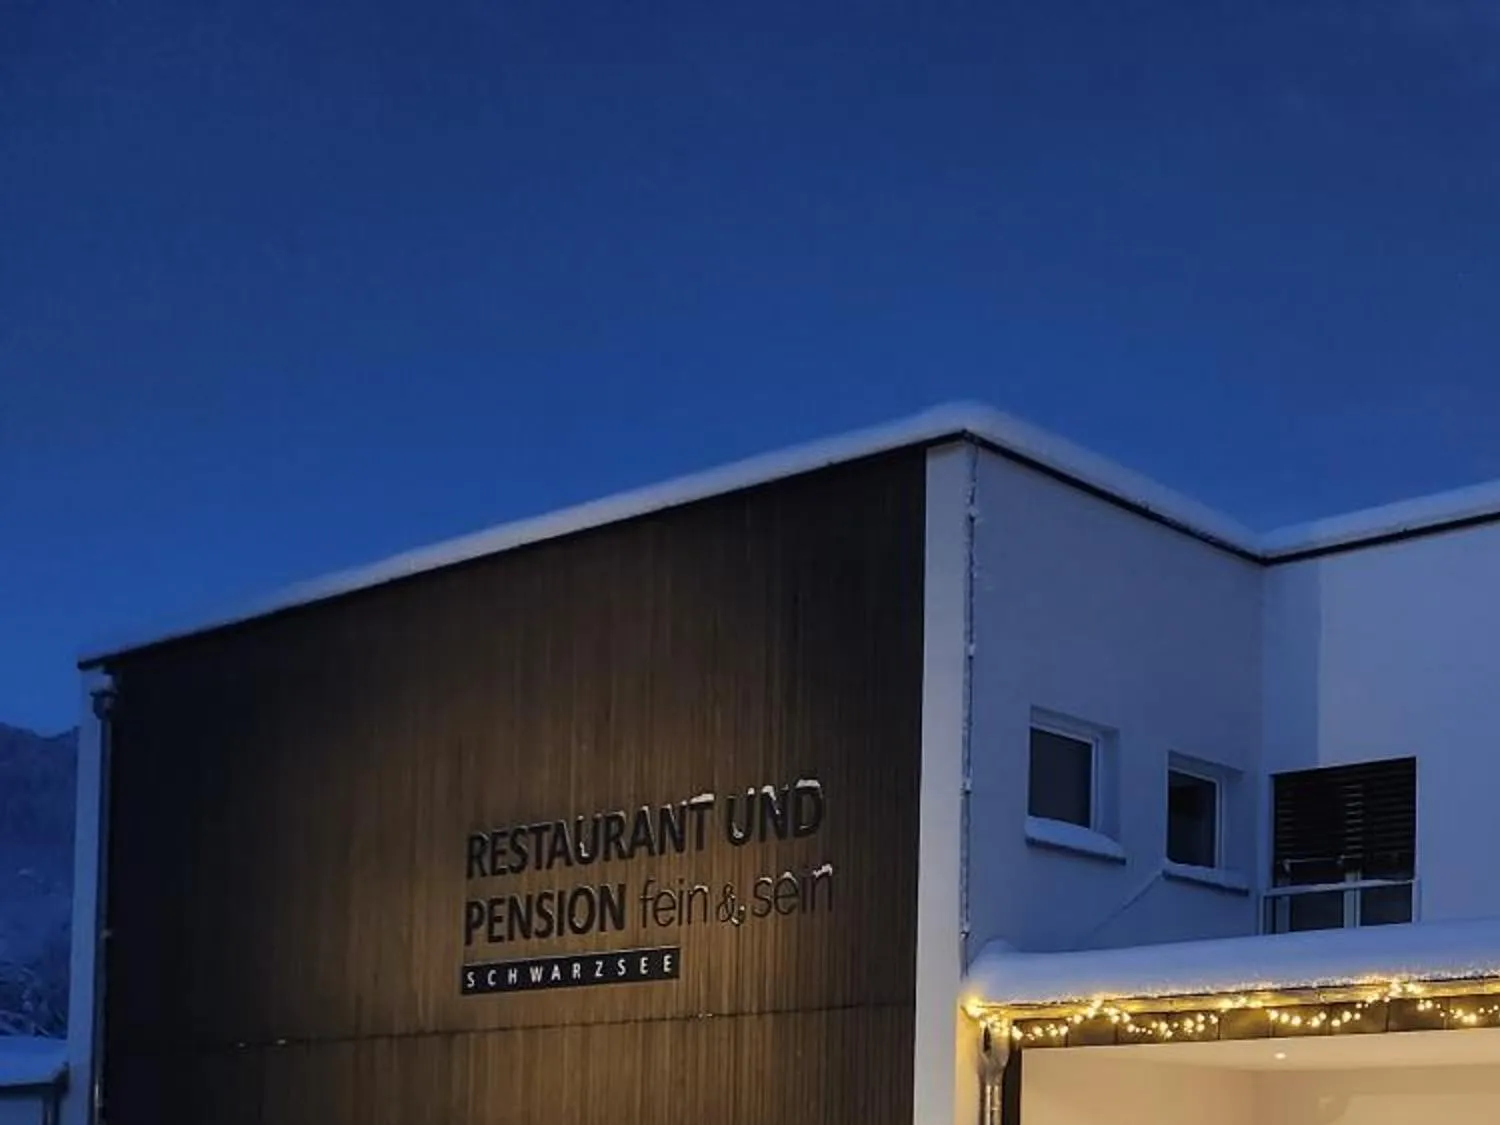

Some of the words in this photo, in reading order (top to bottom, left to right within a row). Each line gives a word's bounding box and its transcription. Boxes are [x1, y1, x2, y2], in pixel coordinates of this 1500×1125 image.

[465, 796, 714, 880] RESTAURANT
[726, 782, 824, 847] UND
[464, 883, 627, 946] PENSION
[640, 878, 708, 929] fein
[466, 953, 673, 989] SCHWARZSEE
